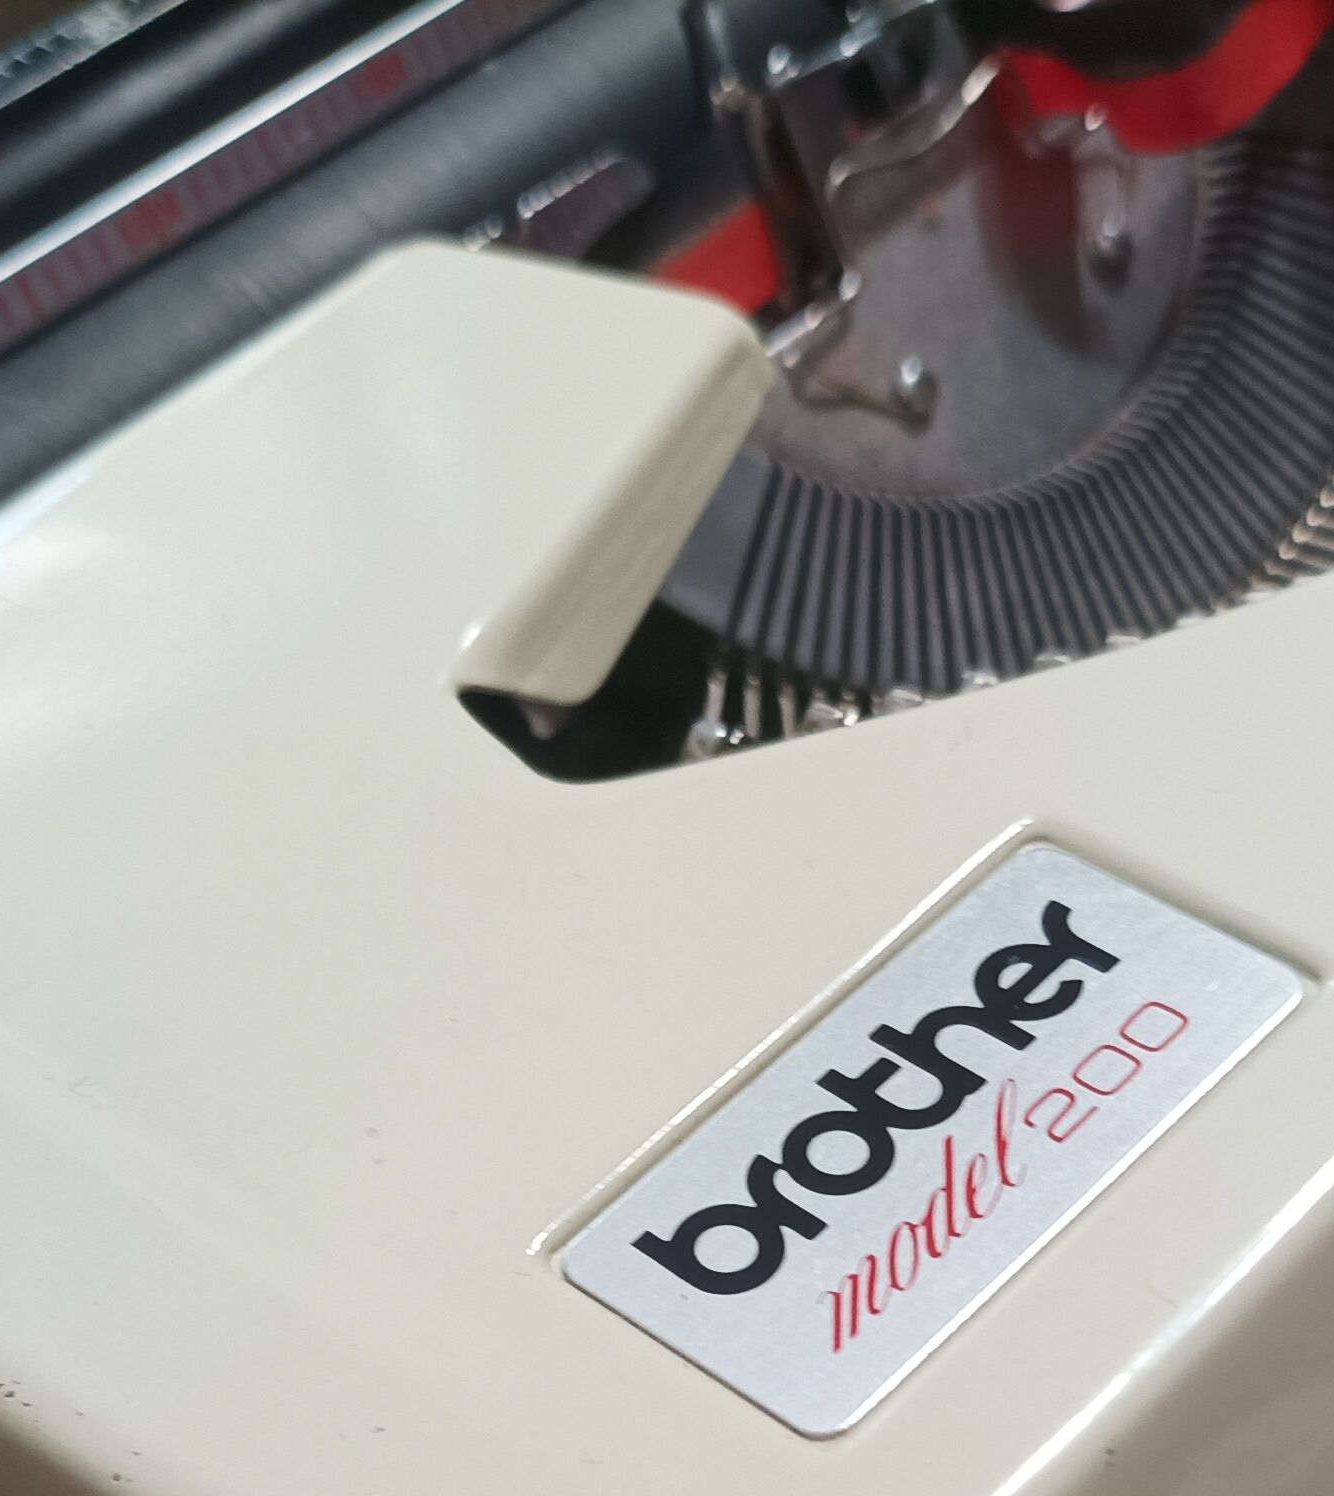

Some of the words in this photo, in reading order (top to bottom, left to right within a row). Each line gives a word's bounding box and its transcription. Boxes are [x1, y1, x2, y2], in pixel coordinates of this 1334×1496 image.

[631, 899, 1121, 1296] brother
[819, 1078, 1027, 1353] model
[1023, 1000, 1190, 1144] 200
